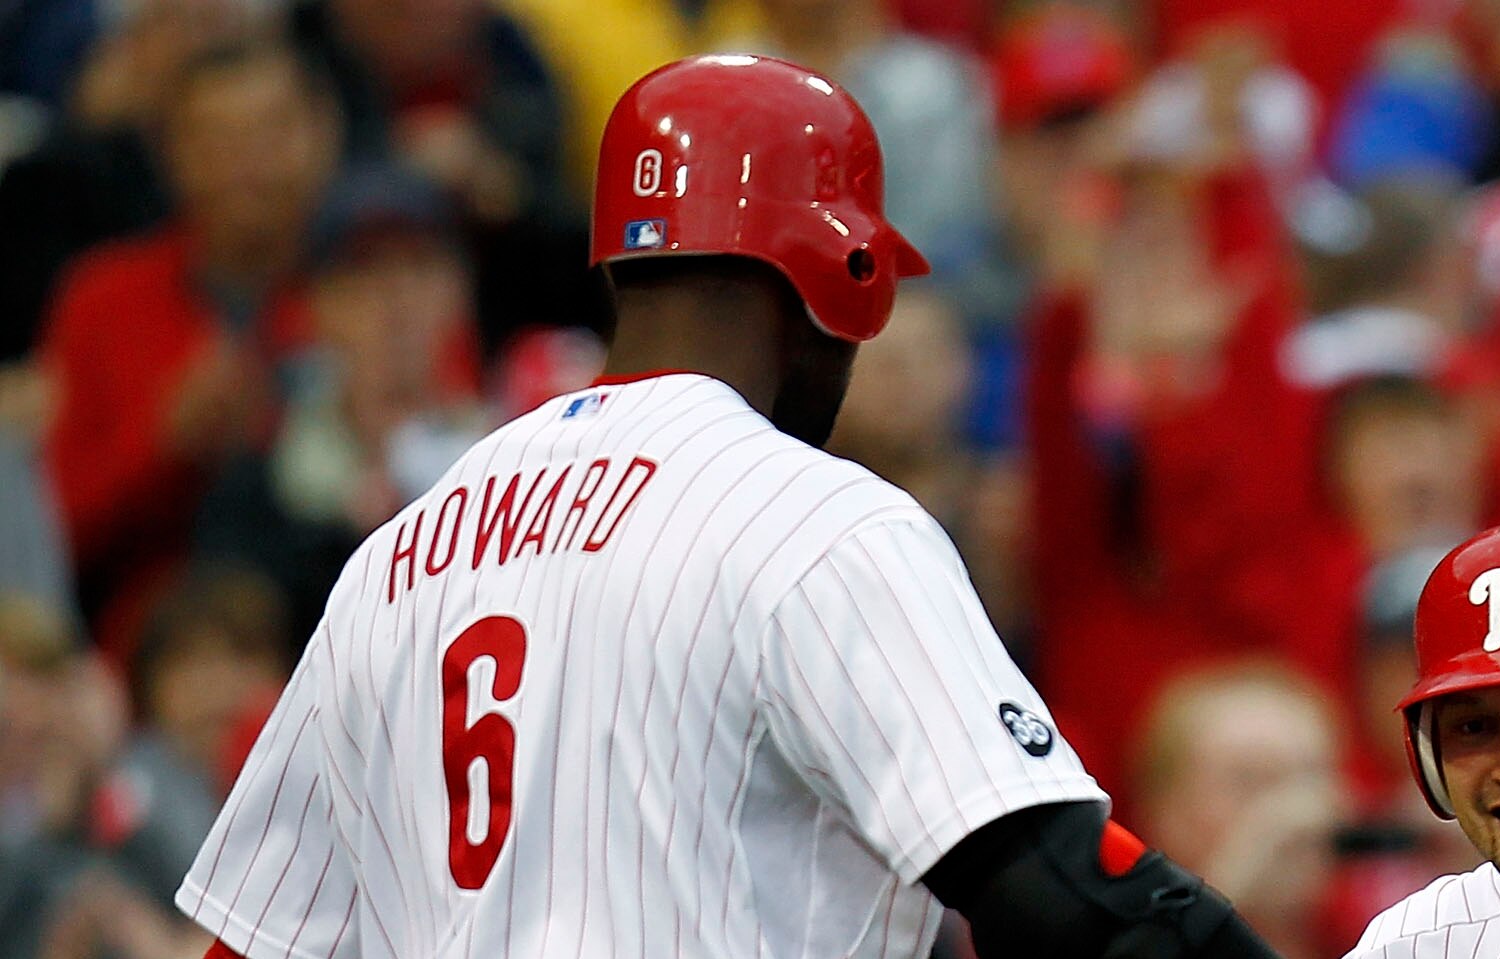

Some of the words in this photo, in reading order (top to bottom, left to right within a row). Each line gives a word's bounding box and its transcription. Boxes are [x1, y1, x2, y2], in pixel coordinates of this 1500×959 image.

[632, 148, 663, 198] 6
[387, 456, 658, 605] HOWARD
[441, 614, 528, 891] 6
